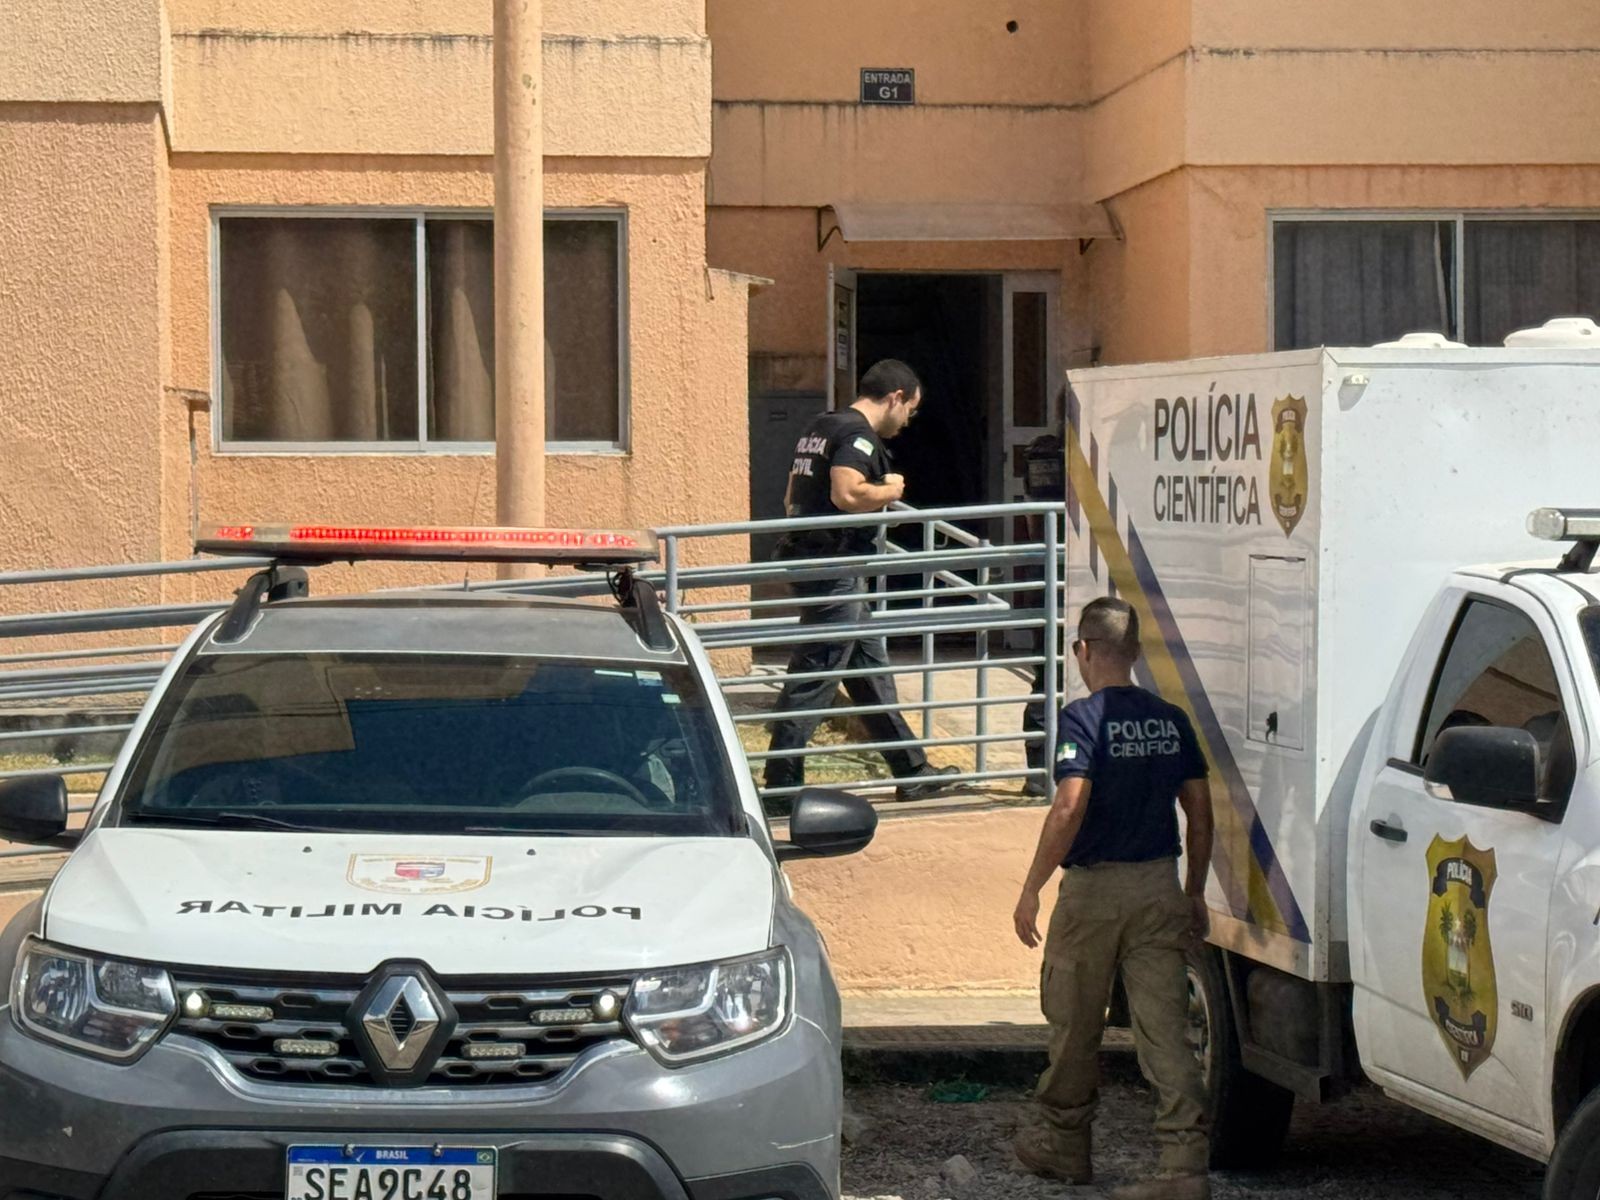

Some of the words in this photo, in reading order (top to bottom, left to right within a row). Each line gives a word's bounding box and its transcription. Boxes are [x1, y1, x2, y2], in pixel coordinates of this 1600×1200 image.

[864, 72, 911, 84] ENTRADA
[879, 86, 899, 99] G1
[1154, 381, 1262, 462] POLÍCIA
[1153, 465, 1262, 526] CIENTÍFICA
[1107, 719, 1181, 741] POLCIA
[376, 1150, 409, 1160] BRASIL
[304, 1167, 472, 1200] SEA9C48
